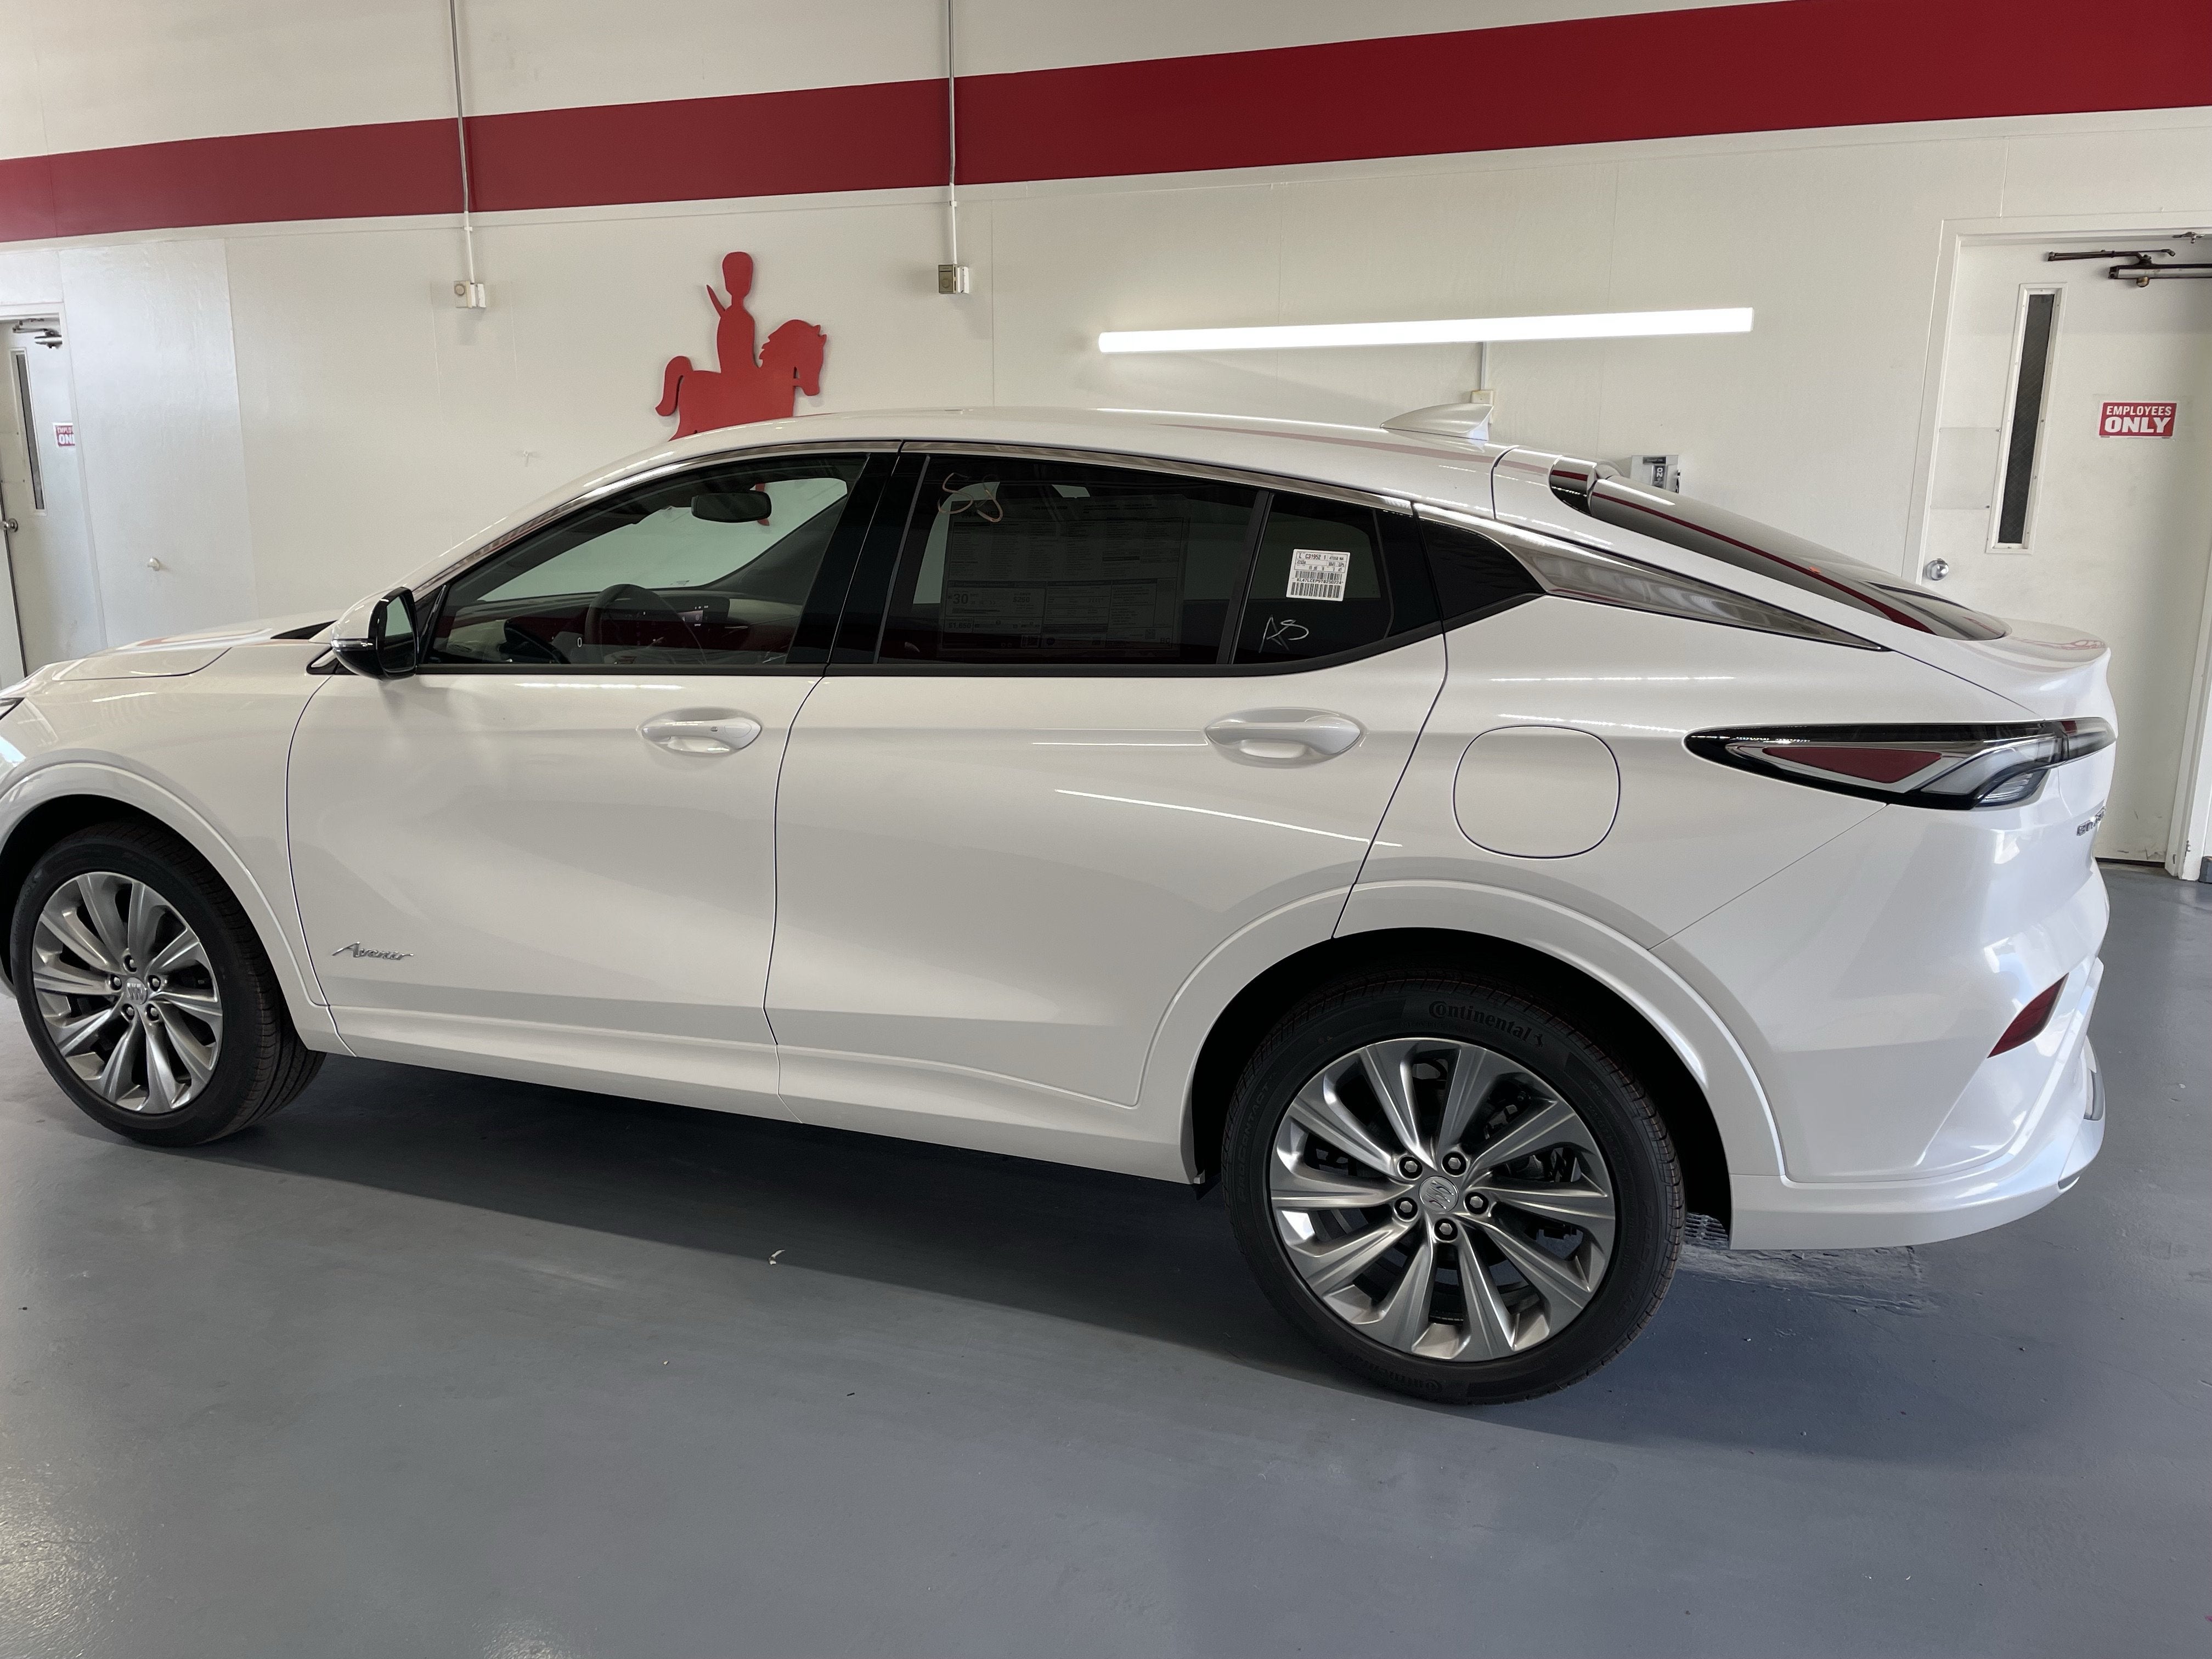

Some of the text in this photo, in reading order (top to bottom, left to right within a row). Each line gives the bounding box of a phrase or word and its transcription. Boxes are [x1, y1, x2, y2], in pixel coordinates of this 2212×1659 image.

[2107, 405, 2172, 416] EMPLOYEES
[2104, 416, 2171, 433] ONLY
[1429, 1001, 1532, 1042] Continental
